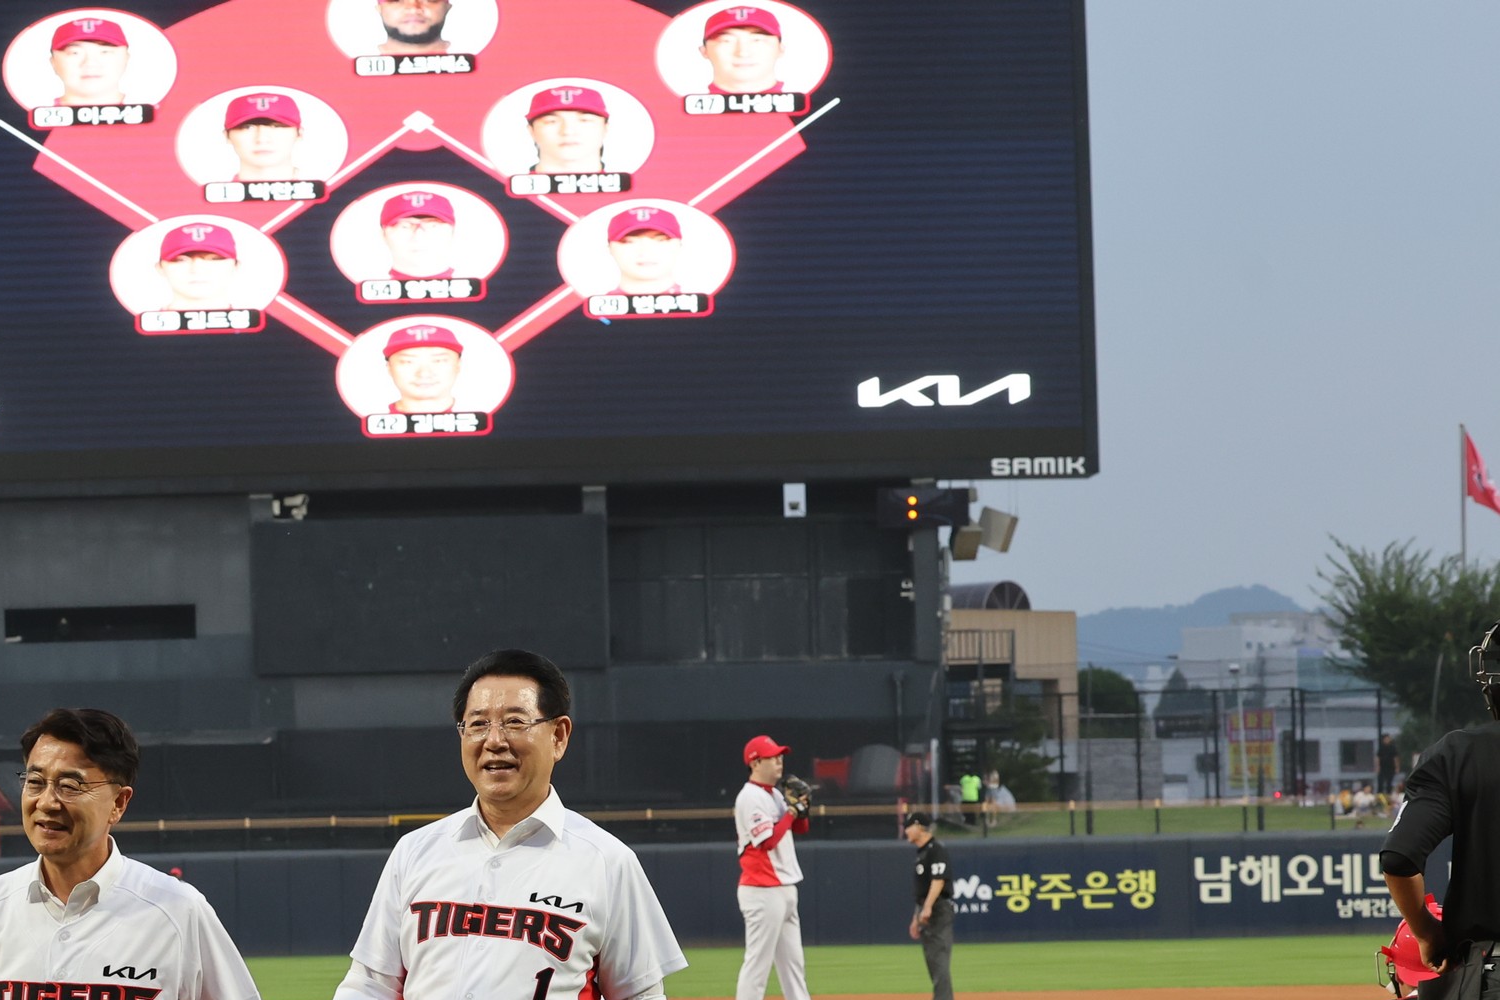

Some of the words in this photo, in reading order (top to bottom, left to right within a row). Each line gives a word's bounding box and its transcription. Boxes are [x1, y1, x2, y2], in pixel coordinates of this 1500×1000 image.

[990, 456, 1086, 476] SAMIK
[994, 868, 1157, 913] 광주은행
[410, 900, 587, 962] TIGERS
